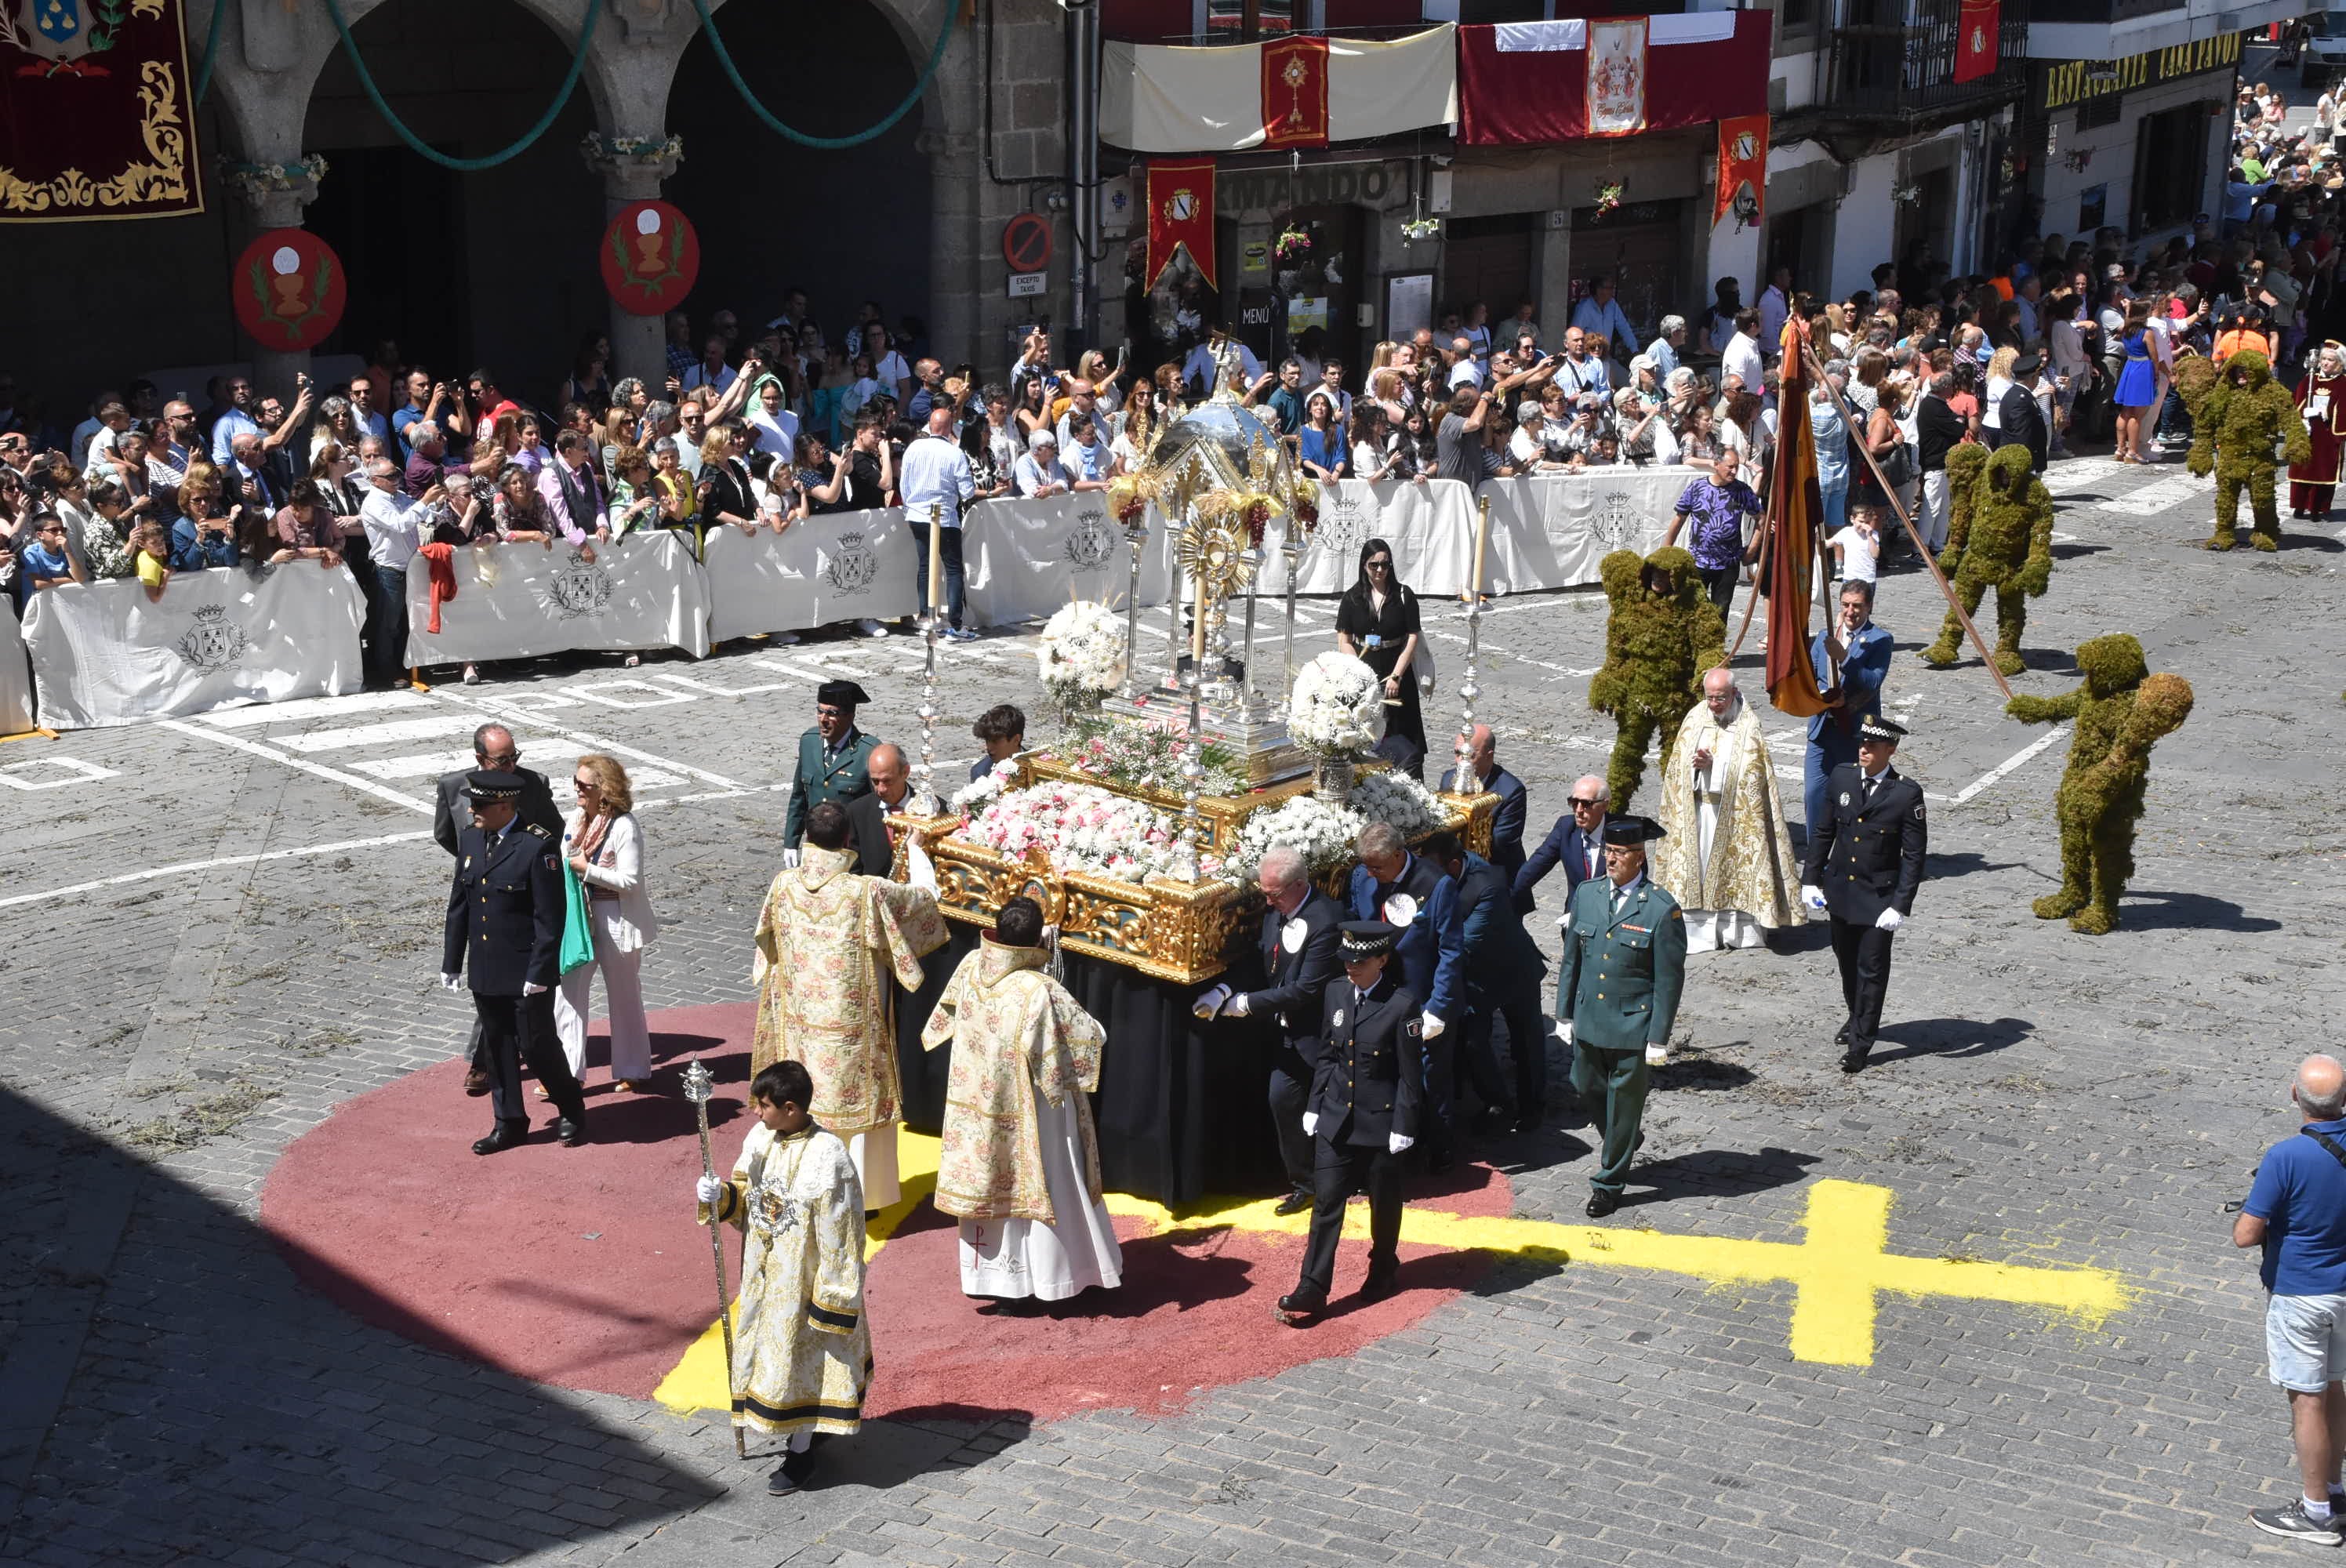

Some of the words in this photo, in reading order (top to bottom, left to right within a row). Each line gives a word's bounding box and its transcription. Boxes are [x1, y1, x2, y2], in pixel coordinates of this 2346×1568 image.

[2159, 42, 2193, 80] CASA
[1016, 276, 1040, 285] EXCEPTO
[1242, 305, 1269, 325] MENÚ
